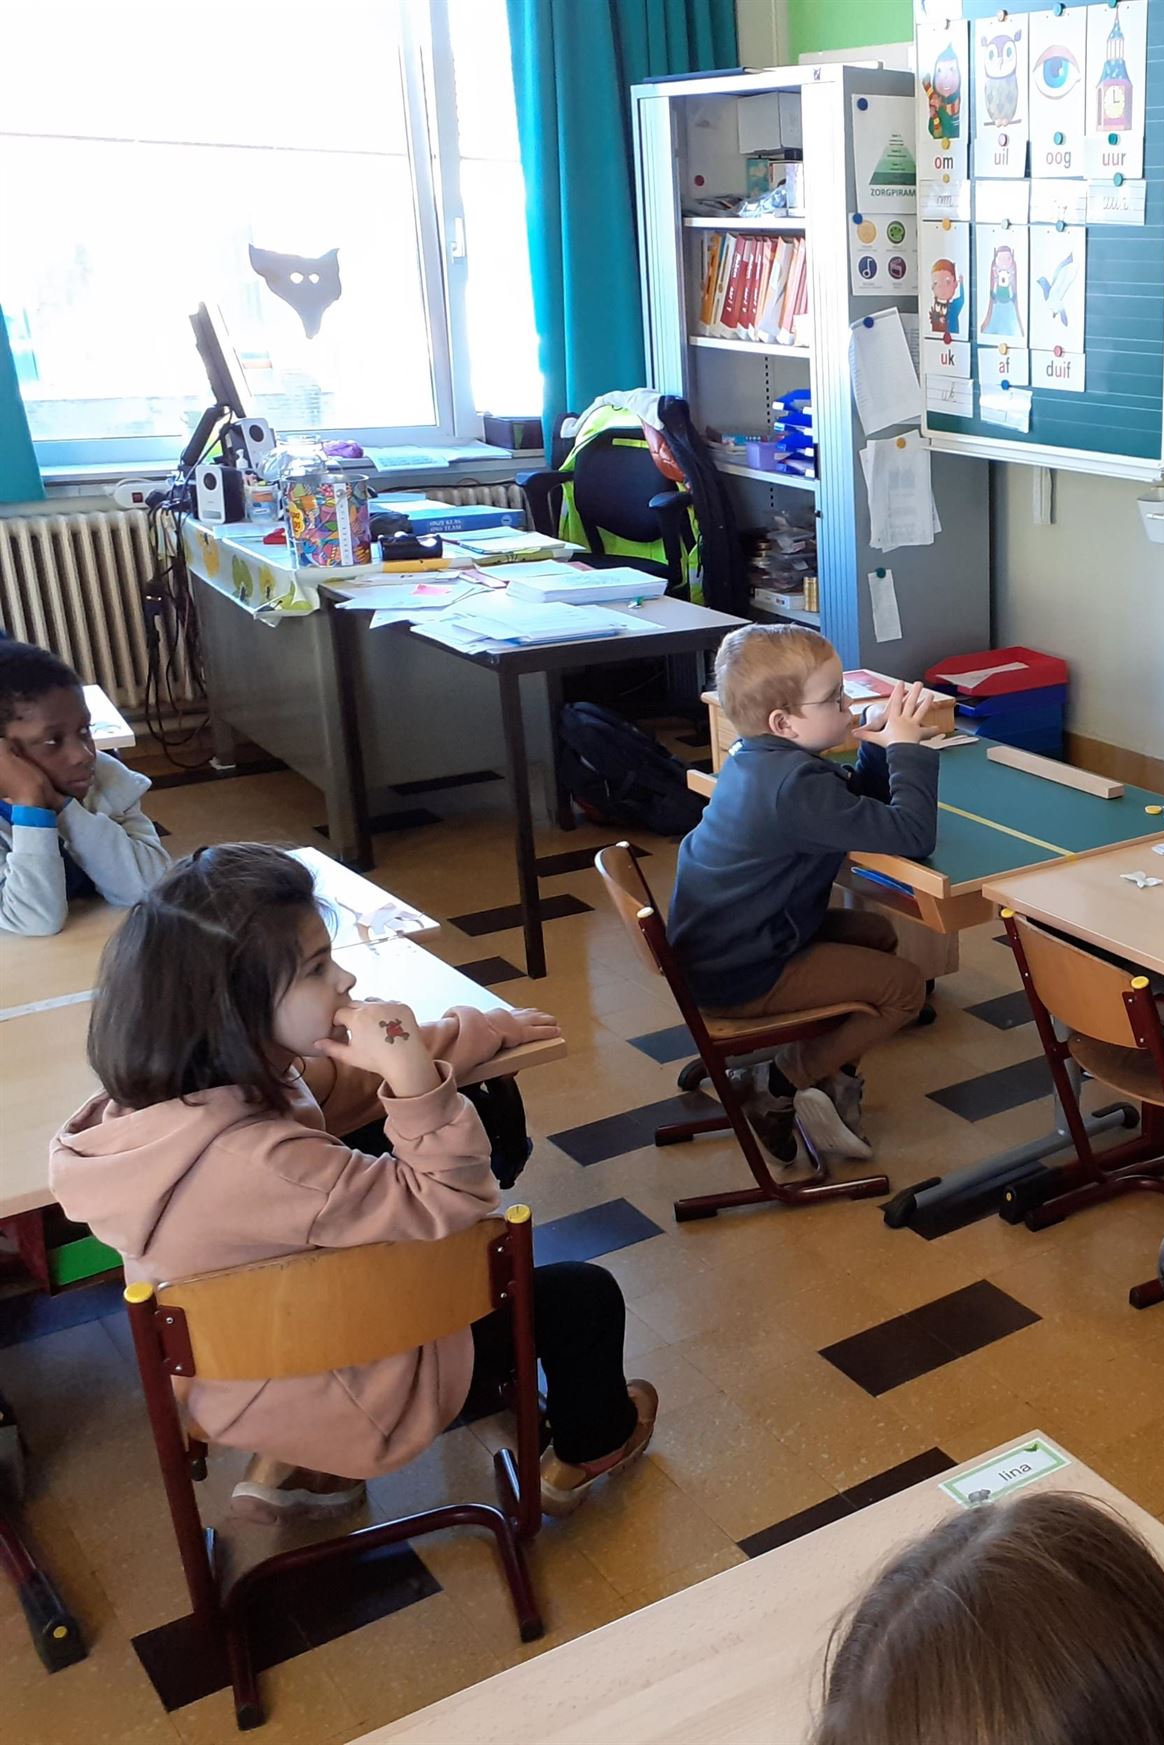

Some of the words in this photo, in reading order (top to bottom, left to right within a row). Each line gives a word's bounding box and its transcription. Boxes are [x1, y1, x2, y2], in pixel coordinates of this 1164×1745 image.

[934, 155, 954, 170] om
[993, 148, 1009, 167] uil
[1045, 150, 1072, 169] oog
[1102, 150, 1127, 167] uur
[940, 349, 956, 366] uk
[998, 356, 1010, 374] af
[1046, 360, 1072, 379] duif
[998, 1462, 1033, 1482] lina
